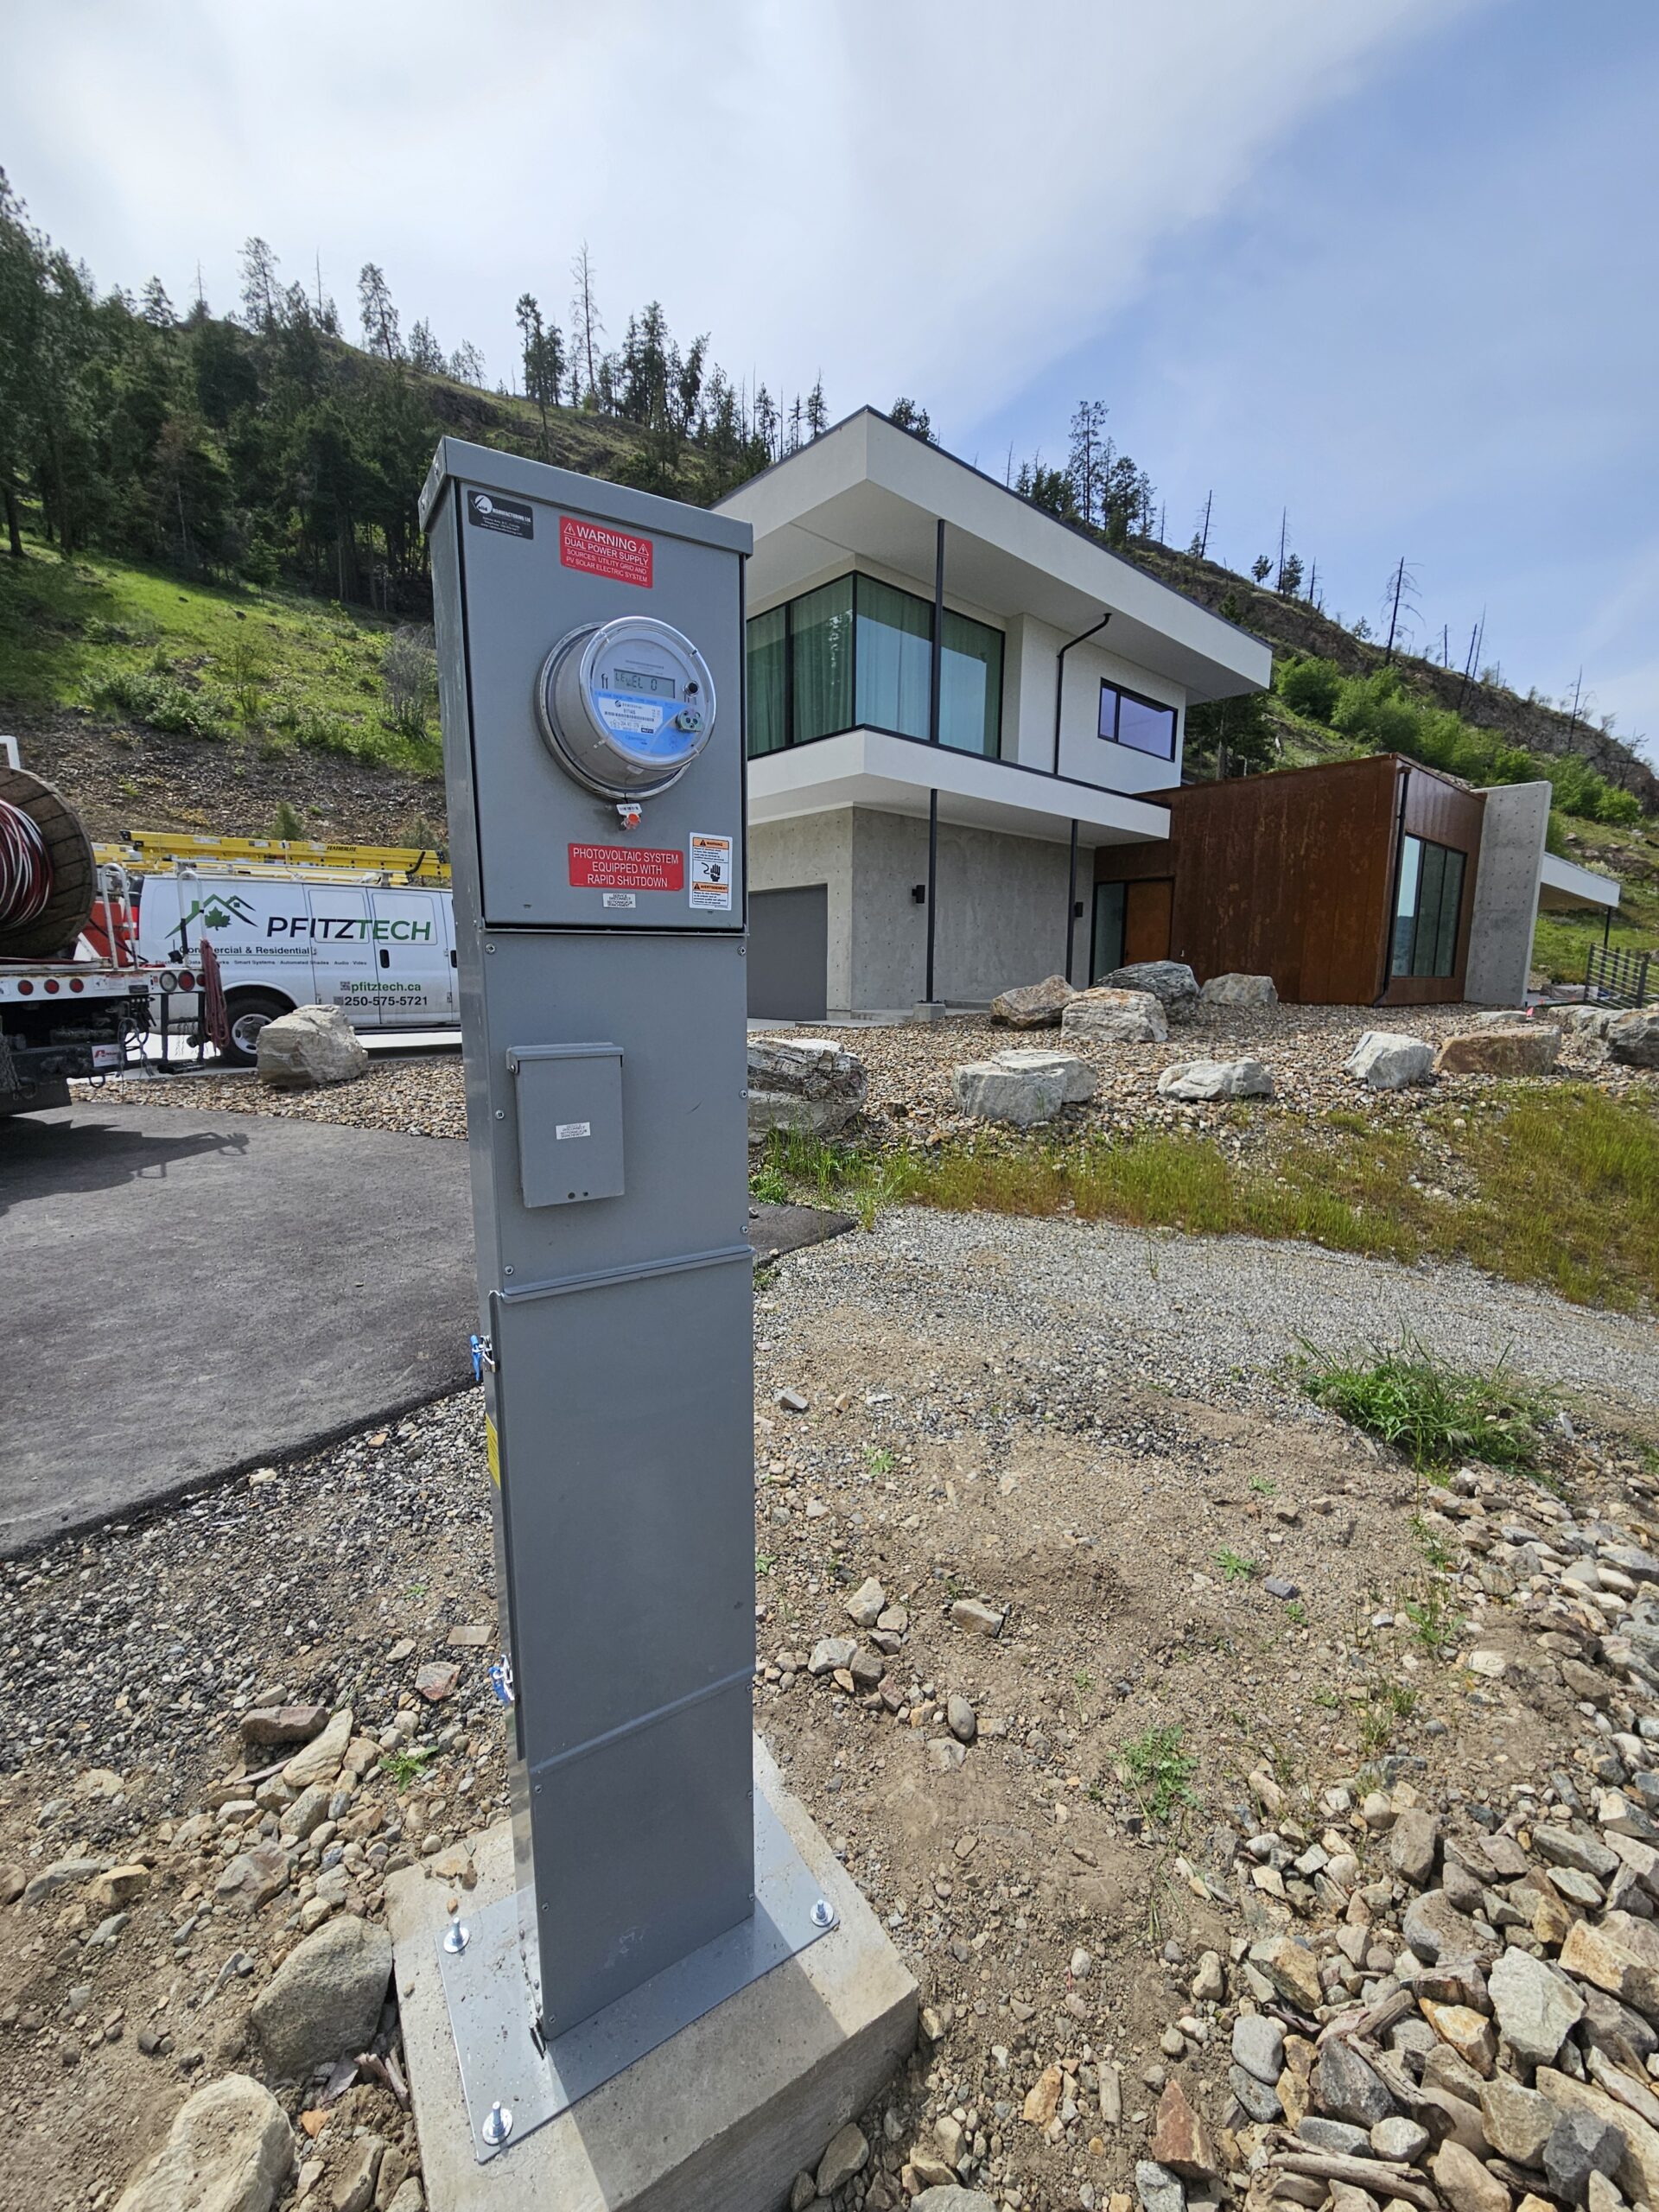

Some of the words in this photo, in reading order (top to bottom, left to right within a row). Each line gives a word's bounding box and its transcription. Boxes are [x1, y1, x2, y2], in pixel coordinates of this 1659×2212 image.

[576, 524, 637, 552] WARNING
[564, 537, 586, 550] DUAL
[588, 543, 618, 558] POWER
[619, 551, 649, 567] SUPPLY
[567, 549, 596, 562] SOURCES:
[598, 556, 620, 567] UTILITY
[620, 562, 634, 571] GRID
[575, 558, 595, 569] SOLAR
[595, 563, 624, 576] ELECTRIC
[625, 571, 648, 582] SYSTEM
[573, 847, 641, 862] PHOTOVOLTAIC
[643, 851, 679, 864] SYSTEM
[592, 861, 639, 874] EQUIPPED
[639, 864, 663, 874] WITH
[587, 874, 615, 885] RAPID
[617, 875, 668, 887] SHUTDOWN
[266, 916, 431, 941] PFITZTECH
[256, 945, 309, 955] Residential
[351, 981, 422, 994] pfitztech.ca
[344, 995, 428, 1007] 250-575-5721
